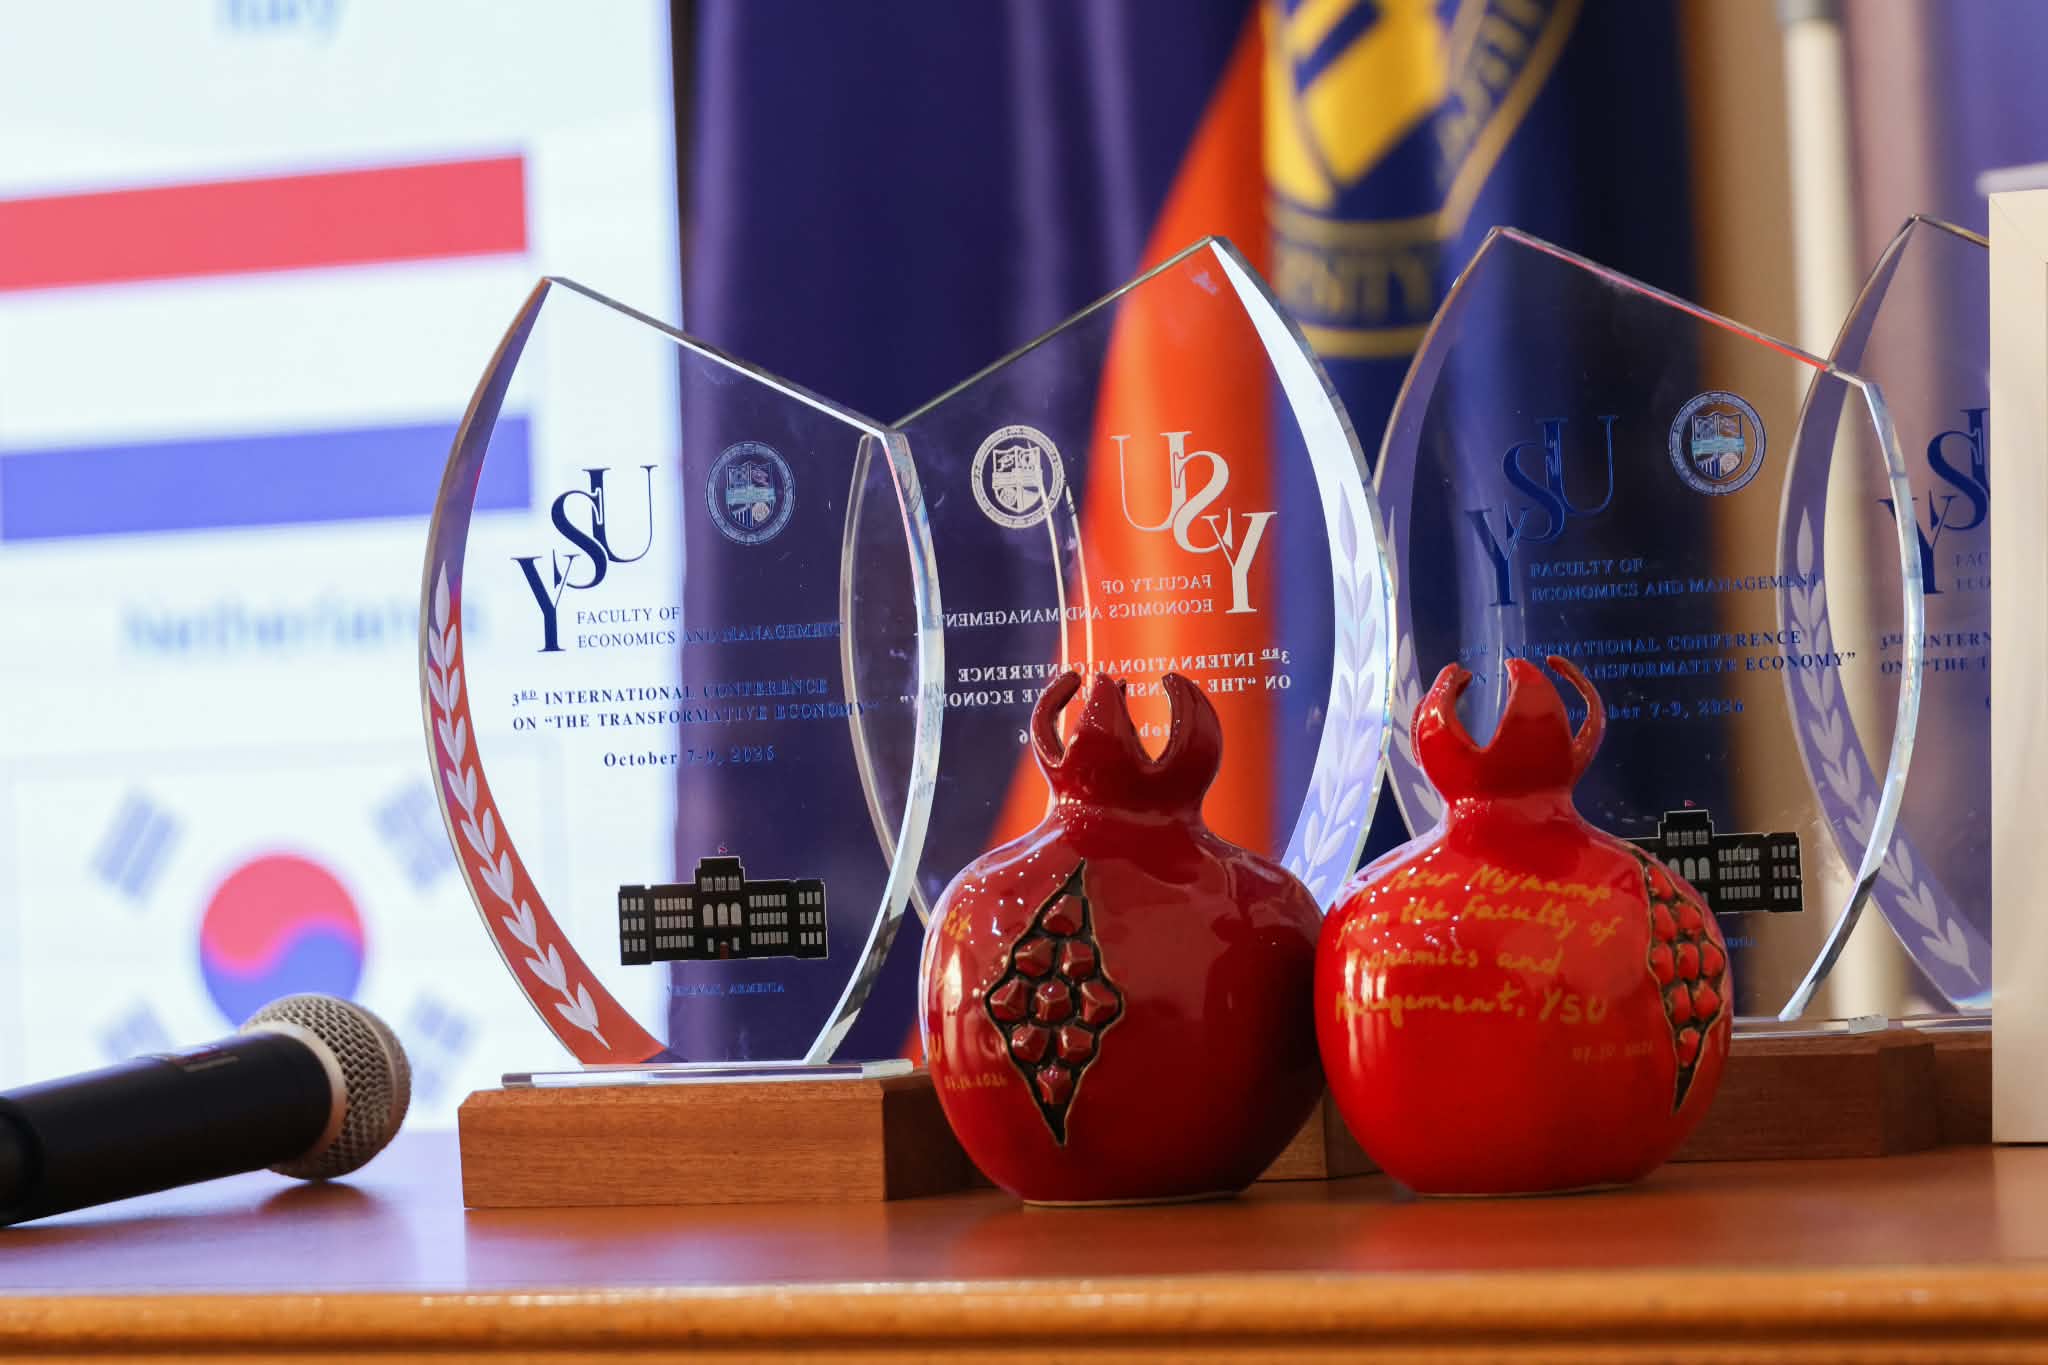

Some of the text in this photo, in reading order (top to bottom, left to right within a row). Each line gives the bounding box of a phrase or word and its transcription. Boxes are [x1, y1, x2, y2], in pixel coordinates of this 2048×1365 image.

[1465, 414, 1619, 607] YSU
[510, 464, 658, 653] YSU
[1529, 557, 1645, 577] FACULTY OF
[1530, 573, 1817, 601] ECONOMICS AND MANAGEMENT
[576, 605, 681, 625] FACULTY OF
[577, 622, 844, 649] ECONOMICS AND MANAGEMENT
[1667, 630, 1801, 650] CONFERENCE
[544, 685, 698, 706] INTERNATIONAL
[703, 678, 828, 699] CONFERENCE
[513, 716, 537, 730] ON
[597, 706, 768, 728] TRANSFORMATIVE
[603, 750, 678, 768] October
[1538, 990, 1609, 1026] YSU
